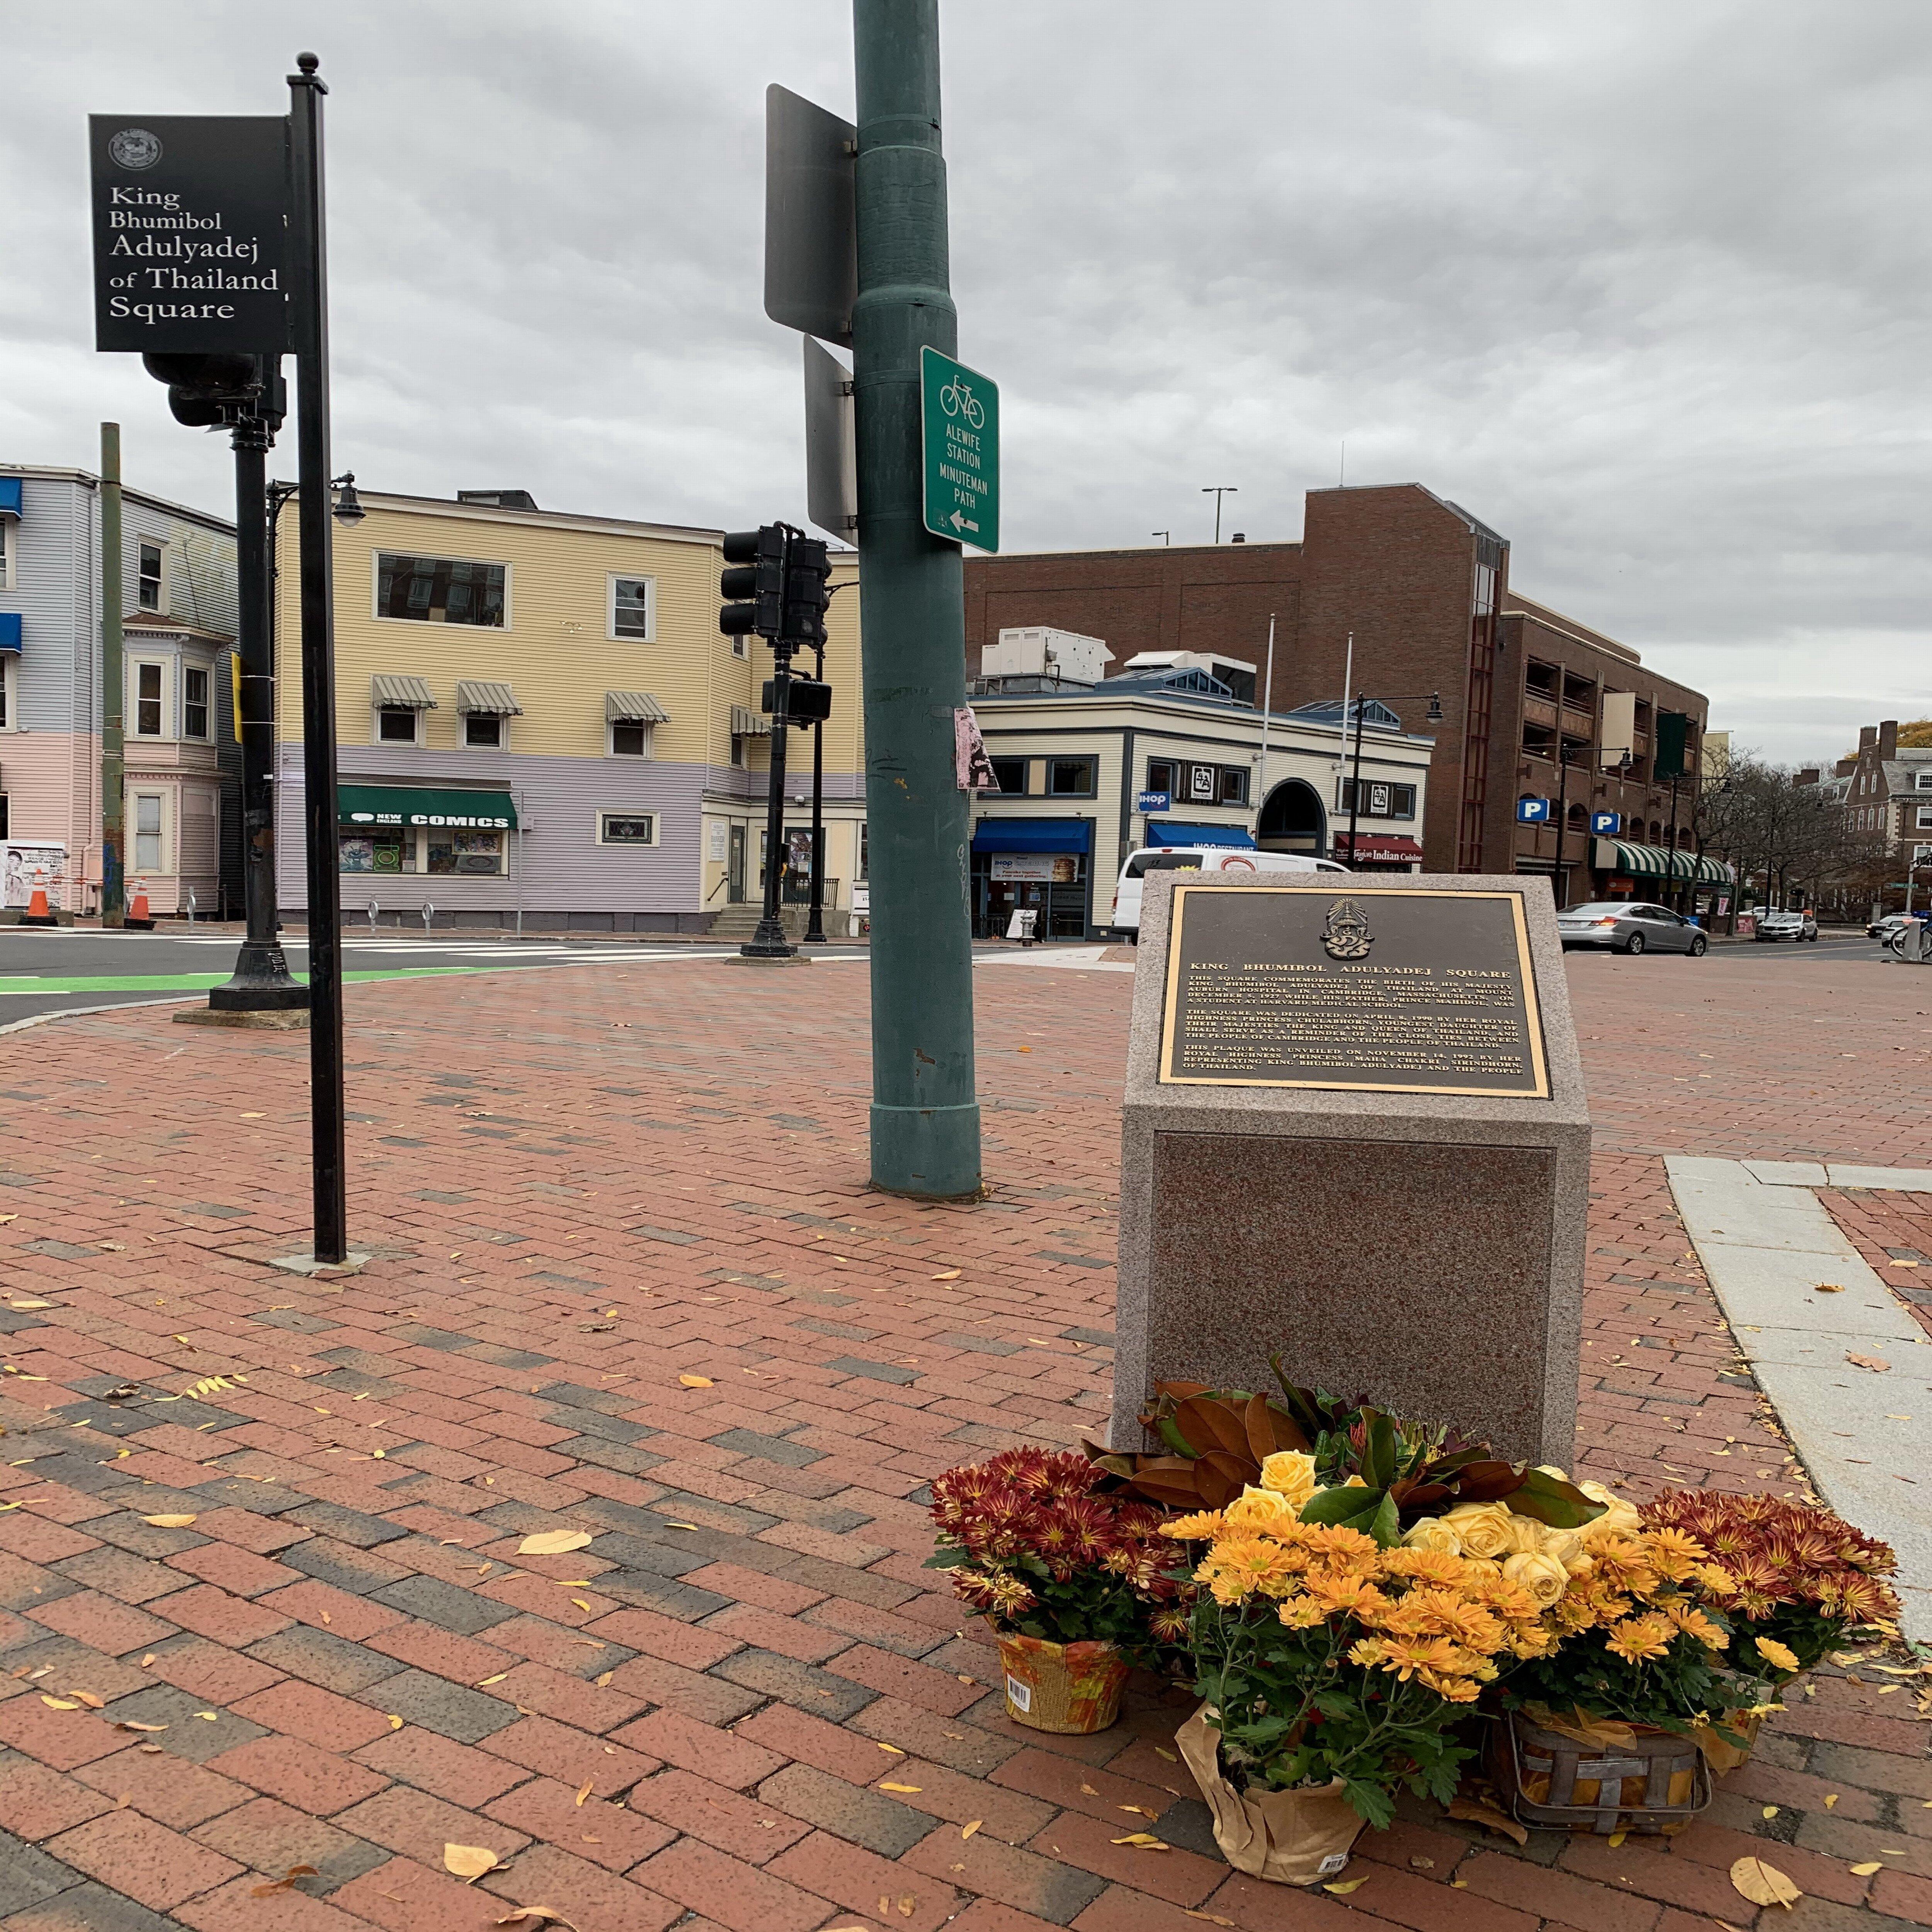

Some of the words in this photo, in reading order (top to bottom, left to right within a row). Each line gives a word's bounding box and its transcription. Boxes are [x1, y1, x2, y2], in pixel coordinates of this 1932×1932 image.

[110, 187, 180, 210] King
[108, 211, 222, 230] Bhumibol
[109, 234, 258, 265] Adulyadej
[109, 272, 138, 288] of
[145, 267, 279, 291] Thailand
[110, 296, 235, 325] Square
[946, 423, 981, 452] ALEWIFE
[947, 443, 981, 470] STATION
[940, 463, 988, 496] MINUTEMAN
[954, 488, 976, 509] PATH
[1525, 803, 1541, 818] P
[411, 815, 509, 828] COMICS
[1597, 816, 1612, 830] P
[1373, 850, 1399, 860] Indian
[1400, 854, 1423, 862] Cuisine
[1190, 963, 1229, 971] KING
[1243, 964, 1327, 972] BHUMIBOL
[1340, 966, 1431, 976] ADULYADEJ
[1446, 969, 1511, 978] SQUARE
[1397, 992, 1488, 1000] MASSACHUSETTS,
[1451, 1060, 1523, 1068] SIRINDHORN,
